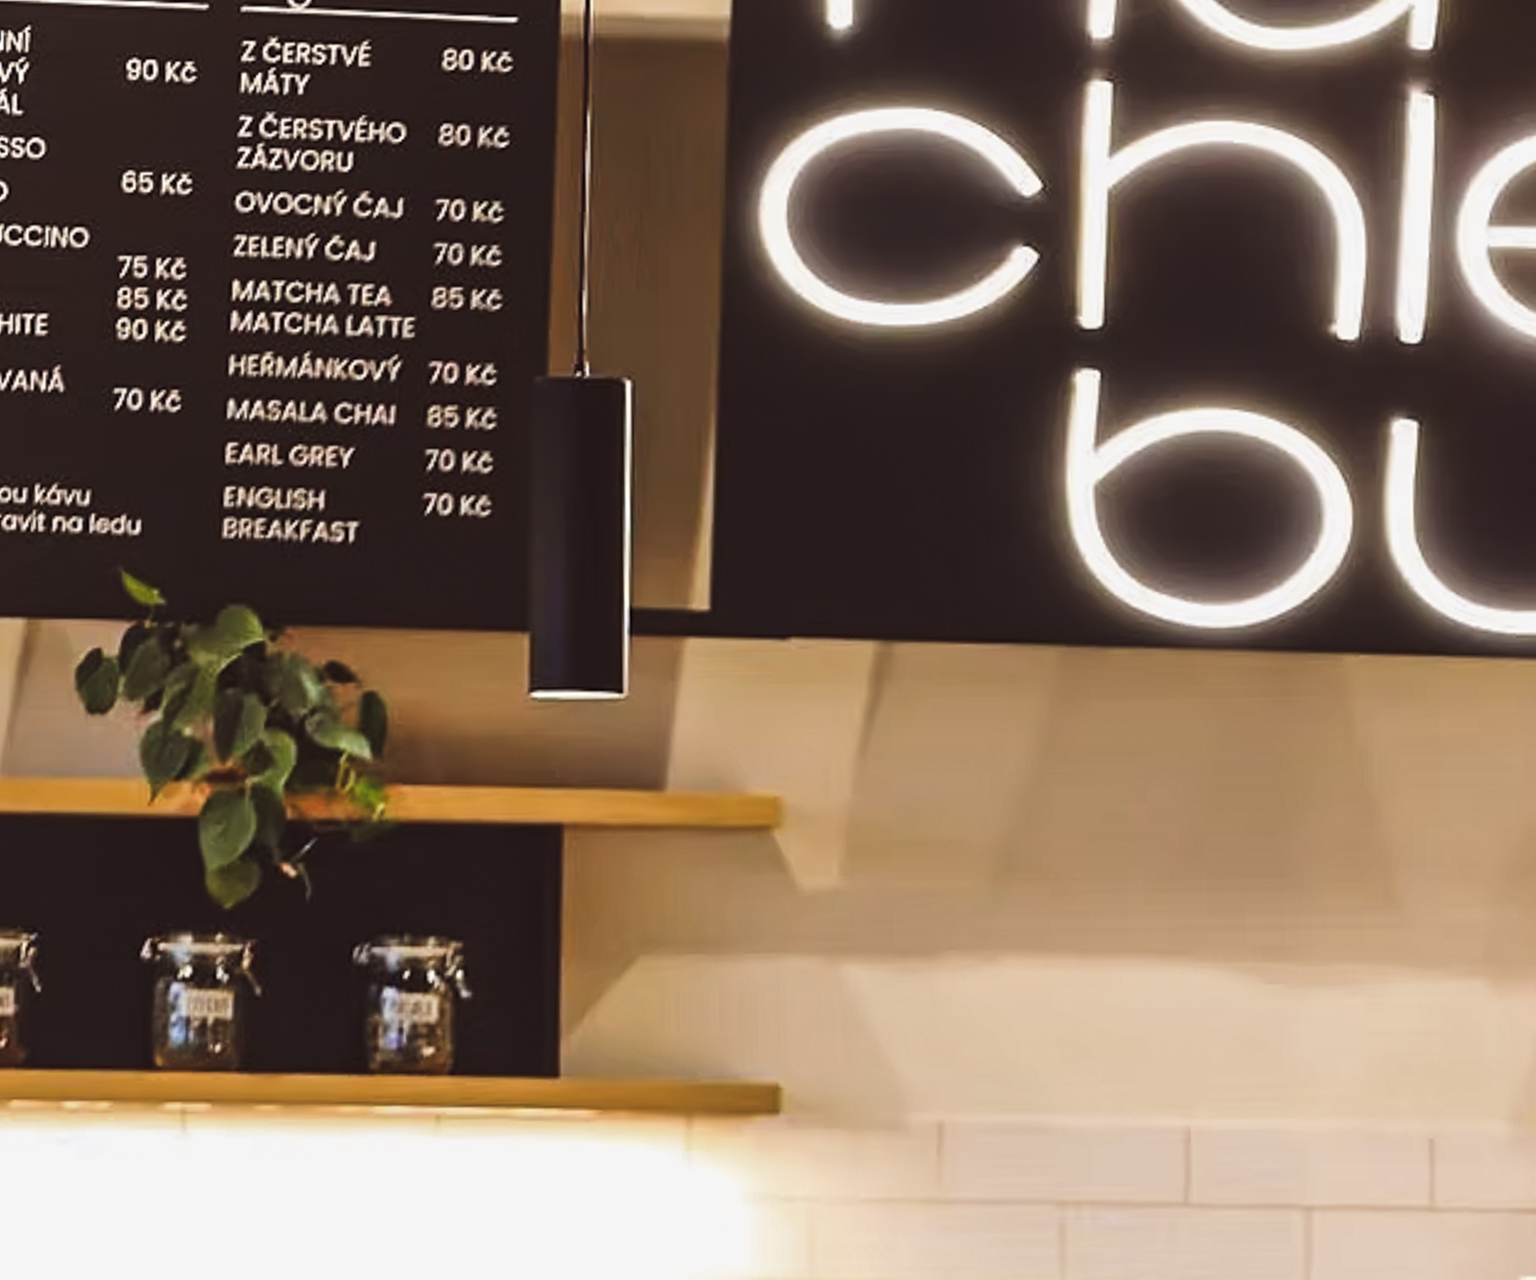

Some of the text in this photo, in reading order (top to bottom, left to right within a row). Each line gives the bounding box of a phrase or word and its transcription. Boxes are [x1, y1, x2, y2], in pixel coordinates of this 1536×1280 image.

[240, 35, 514, 73] Z ČERSTVÉ 80 Kč
[125, 56, 198, 84] 90 Kč
[239, 66, 311, 96] MÁTY
[236, 111, 510, 149] Z ČERSTVÉHO 80 Kč
[235, 141, 354, 173] ZÁZVORU
[120, 169, 193, 196] 65 Kč
[234, 188, 505, 224] OVOCNÝ ČAJ 70 Kč
[233, 232, 503, 268] ZELENÝ ČAJ 70 Kč
[117, 254, 187, 281] 75 Kč
[116, 285, 188, 313] 85 Kč
[231, 278, 503, 312] MATCHA TEA 85 Kč
[115, 316, 187, 343] 90 Kč
[229, 309, 416, 339] MATCHA LATTE
[228, 350, 498, 386] HEŘMÁNKOVÝ 70 Kč
[112, 387, 182, 413] 70 Kč
[226, 397, 498, 430] MASALA CHAI 85 Kč
[224, 441, 494, 474] EARL GREY 70 Kč
[33, 482, 92, 507] kávu
[223, 485, 492, 518] ENGLISH 70 Kč
[51, 512, 142, 536] na ledu
[221, 516, 360, 544] BREAKFAST
